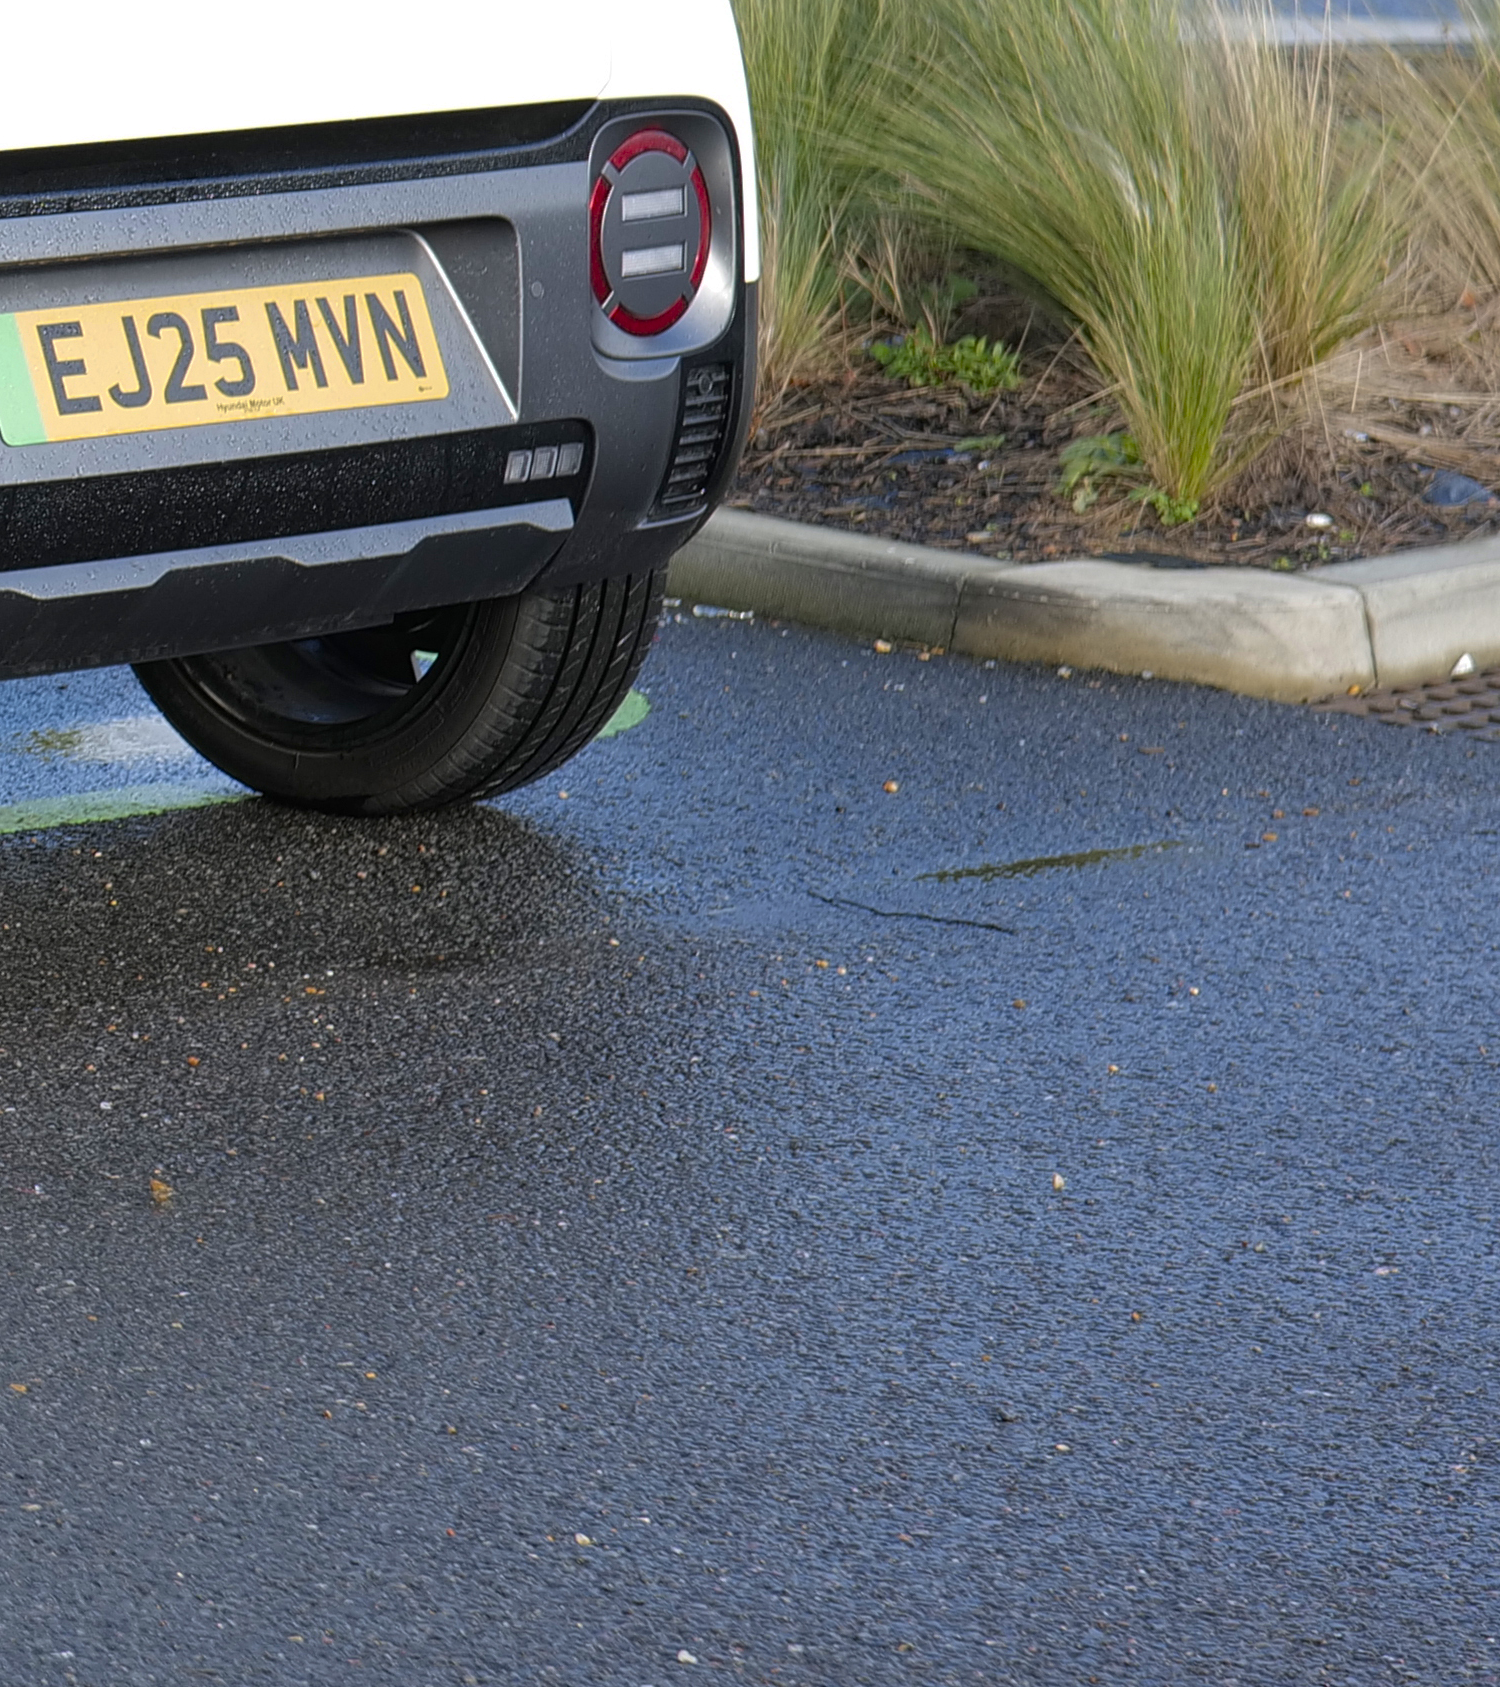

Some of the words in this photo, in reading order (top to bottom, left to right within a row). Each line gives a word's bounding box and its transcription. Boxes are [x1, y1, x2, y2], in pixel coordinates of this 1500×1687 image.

[36, 305, 257, 416] EJ25
[264, 290, 428, 391] MVN
[216, 402, 248, 412] Hyundai
[249, 400, 271, 410] Motor
[272, 397, 285, 406] UK
